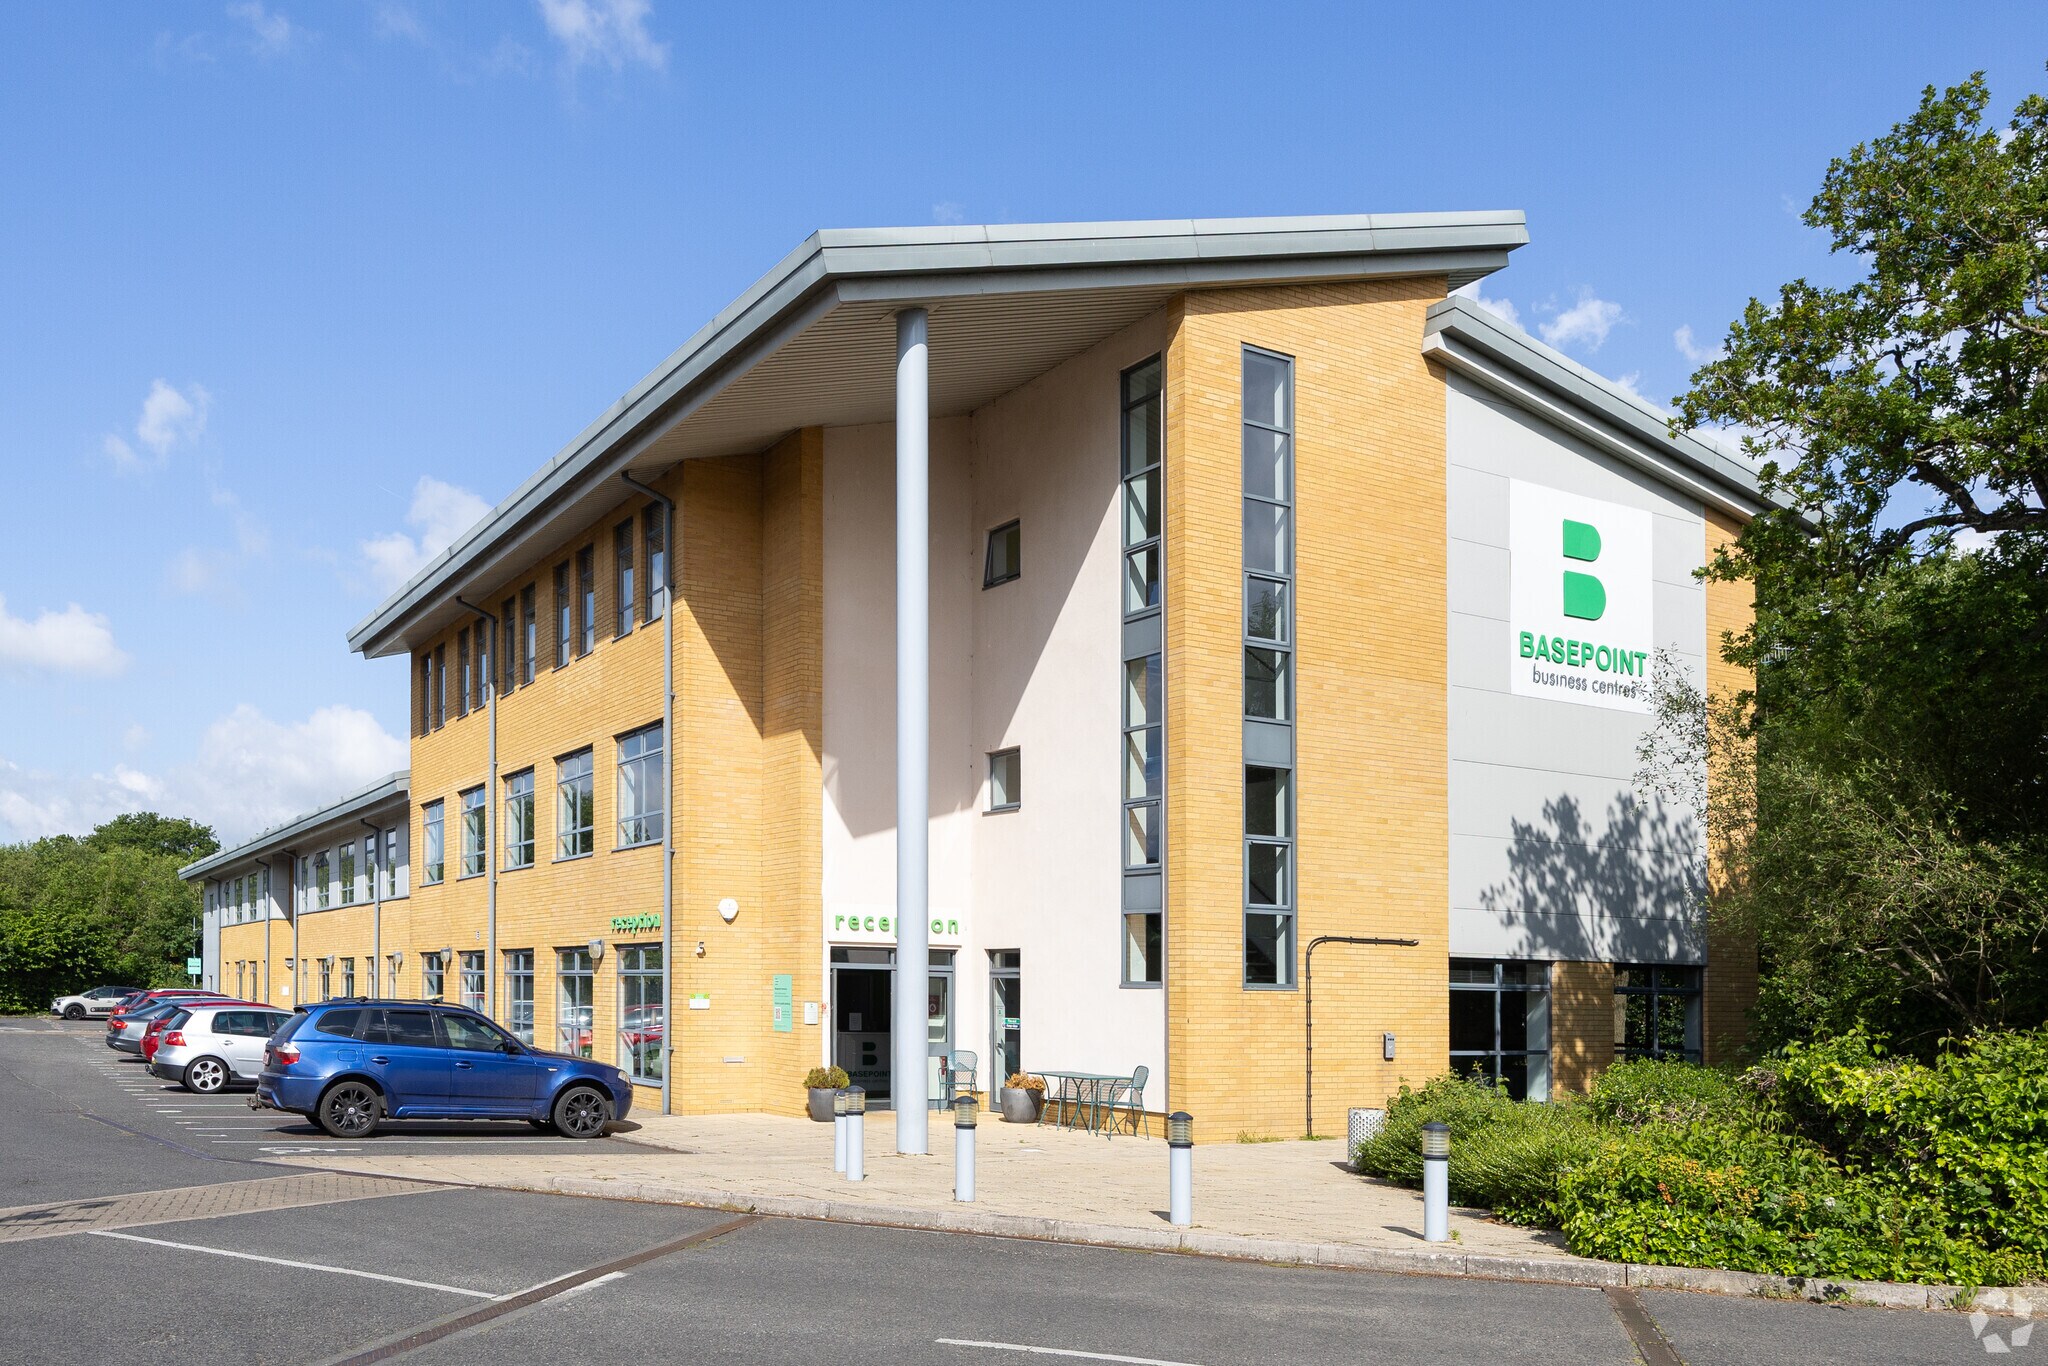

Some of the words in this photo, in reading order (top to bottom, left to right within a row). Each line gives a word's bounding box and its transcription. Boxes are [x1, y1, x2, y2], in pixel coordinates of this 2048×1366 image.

[1519, 630, 1648, 677] BASEPOINT
[1532, 663, 1588, 692] business
[1592, 678, 1637, 699] centres
[610, 911, 661, 935] reception
[835, 914, 959, 938] receon
